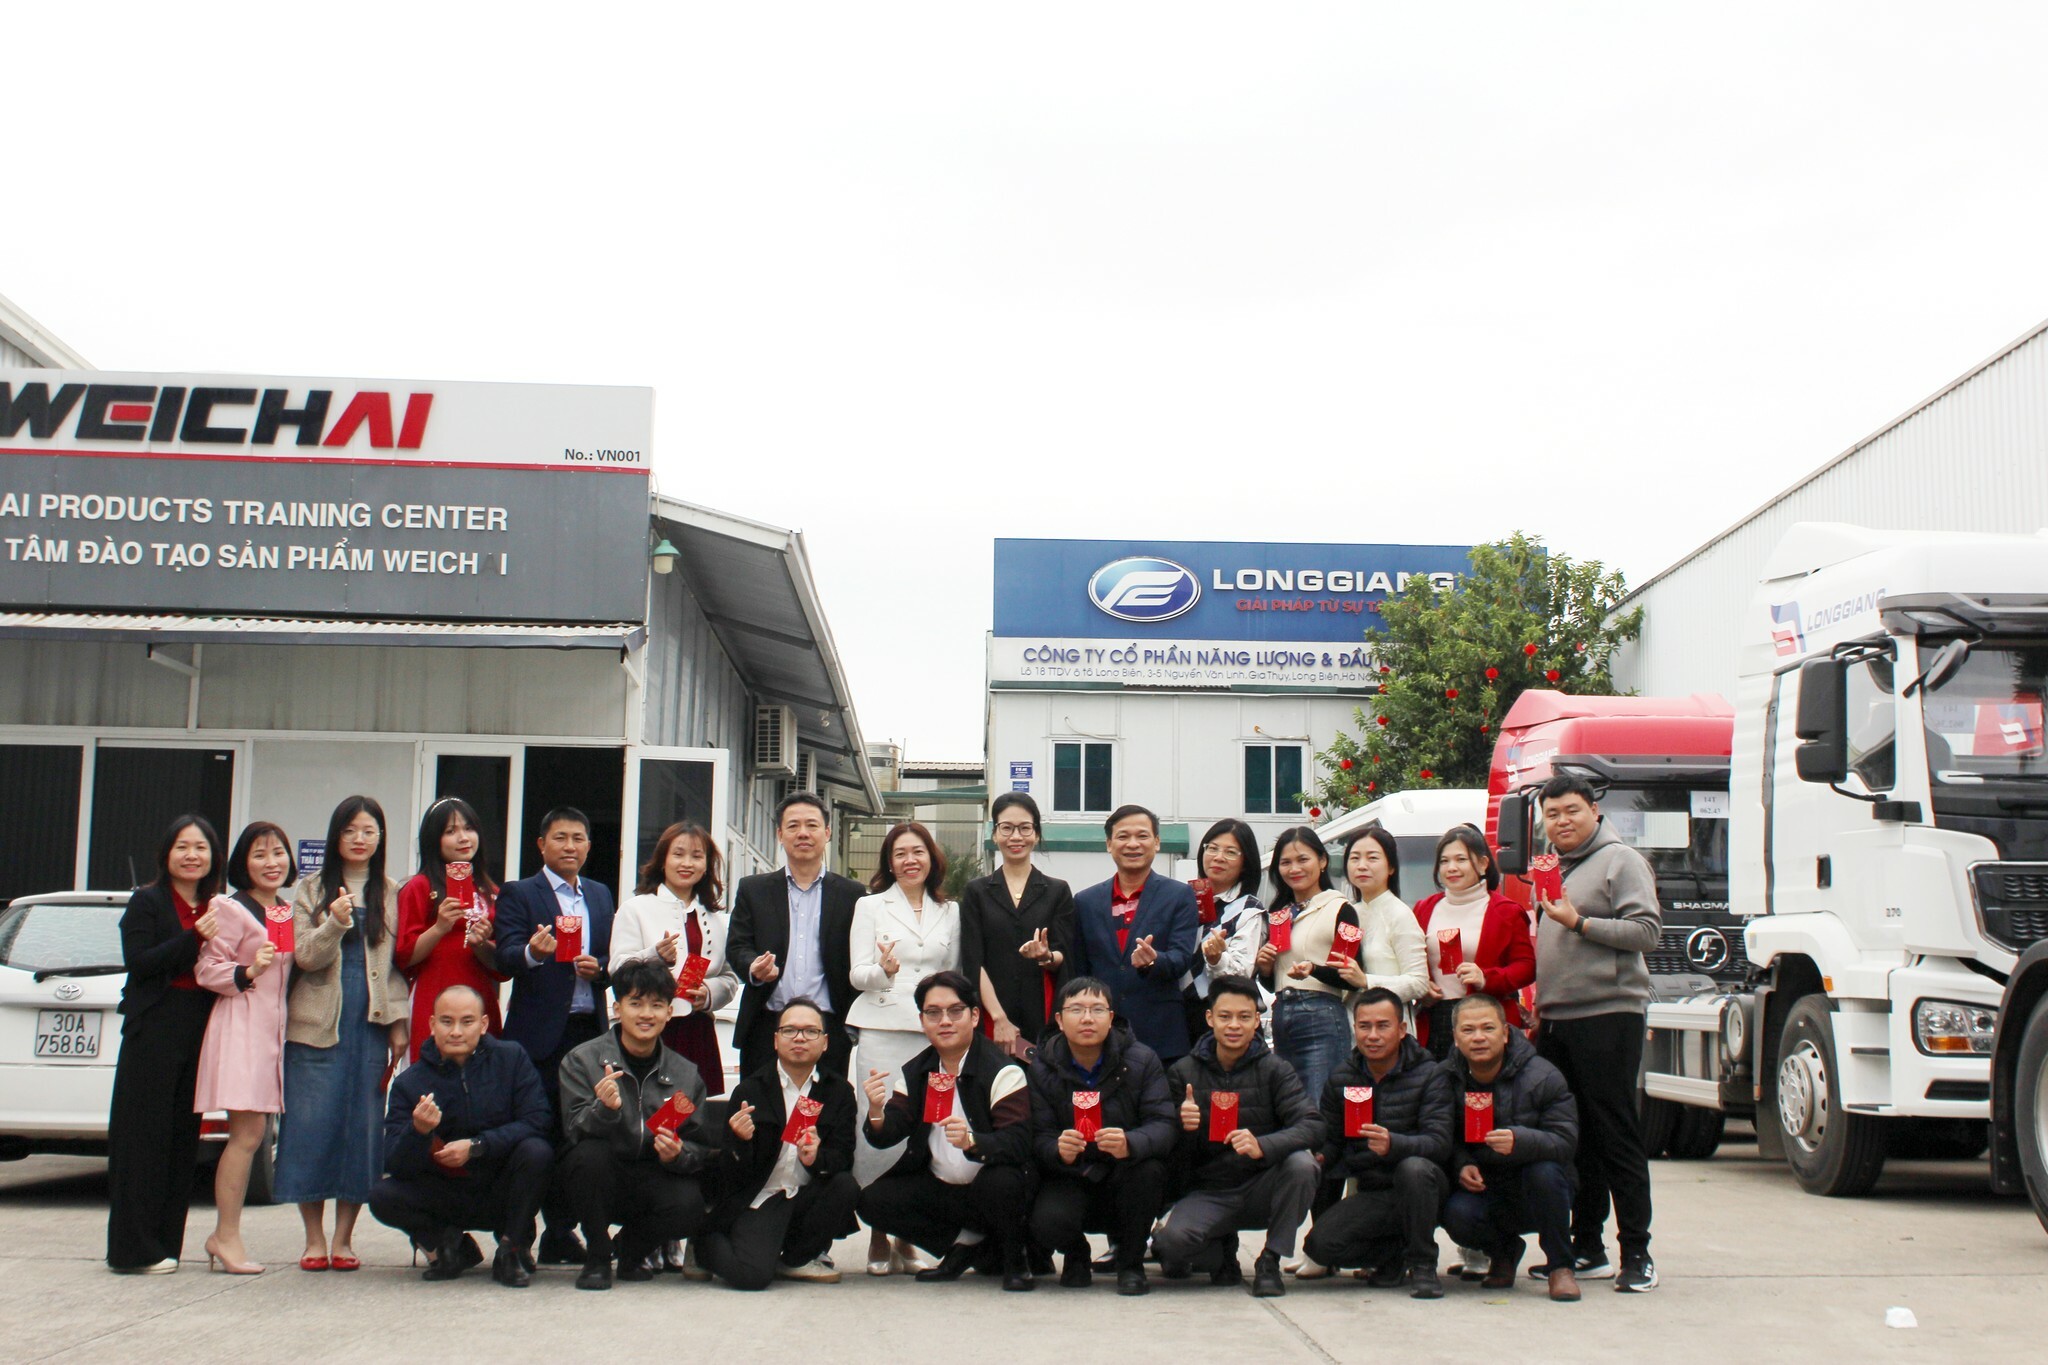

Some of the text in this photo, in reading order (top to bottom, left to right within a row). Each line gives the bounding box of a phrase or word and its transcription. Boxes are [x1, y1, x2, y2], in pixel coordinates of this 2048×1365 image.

[0, 381, 433, 449] WEICHAI
[565, 448, 640, 462] No.: VN001
[40, 494, 213, 523] PRODUCTS
[223, 500, 372, 528] TRAINING
[381, 503, 508, 531] CENTER
[5, 534, 507, 576] TÂM ĐÀO TẠO SẢN PHẨM WEICHI
[1271, 596, 1315, 612] PHÁP
[1023, 644, 1081, 664] CÔNG
[1085, 649, 1106, 664] TY
[1110, 643, 1138, 665] CỔ
[1144, 644, 1192, 666] PHẦN
[1197, 647, 1251, 667] NĂNG
[1256, 650, 1316, 670] LƯỢNG
[1321, 653, 1333, 667] &
[1338, 647, 1372, 668] ĐẦU
[1036, 666, 1046, 676] 18
[1147, 669, 1162, 678] 3-5
[1673, 902, 1730, 910] SHACMA
[53, 1013, 85, 1033] 30A
[38, 1034, 96, 1054] 758.64
